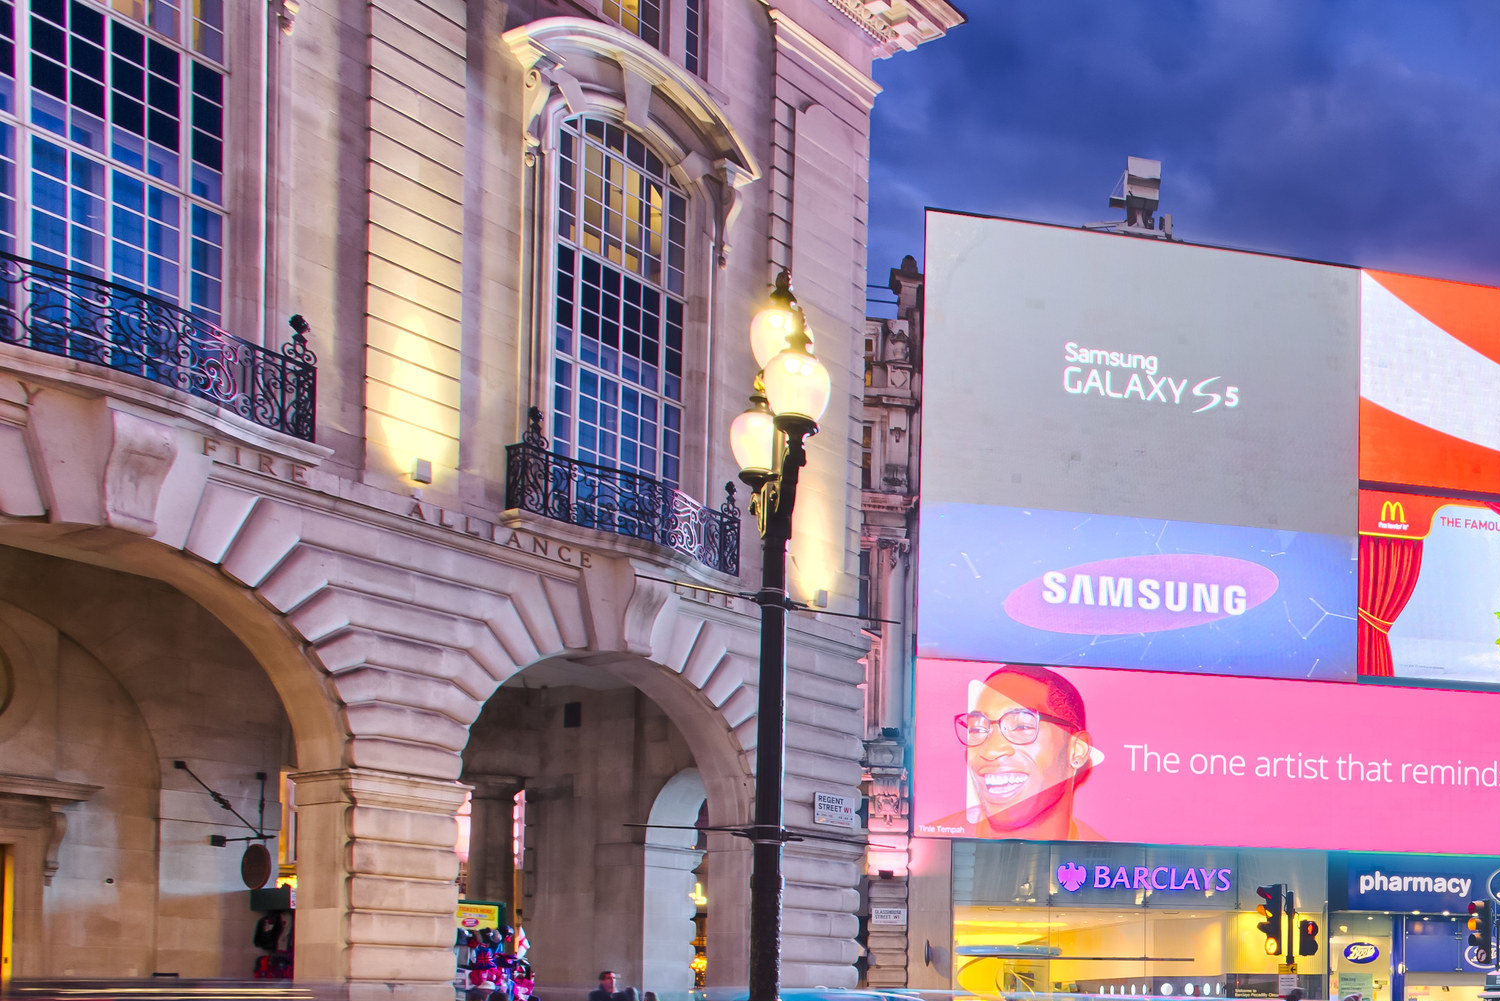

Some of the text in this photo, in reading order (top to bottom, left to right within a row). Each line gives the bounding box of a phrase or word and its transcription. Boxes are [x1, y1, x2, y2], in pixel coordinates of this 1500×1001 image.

[1064, 341, 1159, 375] Samsung
[1063, 366, 1188, 405] GALAXY
[201, 437, 312, 487] FIRE
[408, 502, 592, 569] ALLIANCE
[1440, 516, 1462, 528] THE
[1042, 571, 1248, 616] SAMSUNG
[1123, 744, 1180, 773] The
[1190, 753, 1246, 776] one
[1255, 752, 1329, 781] artist
[1336, 753, 1393, 783] that
[818, 803, 843, 813] STREET
[819, 795, 844, 806] REGENT
[1093, 865, 1232, 892] BARCLAYS
[1359, 870, 1472, 898] pharmacy
